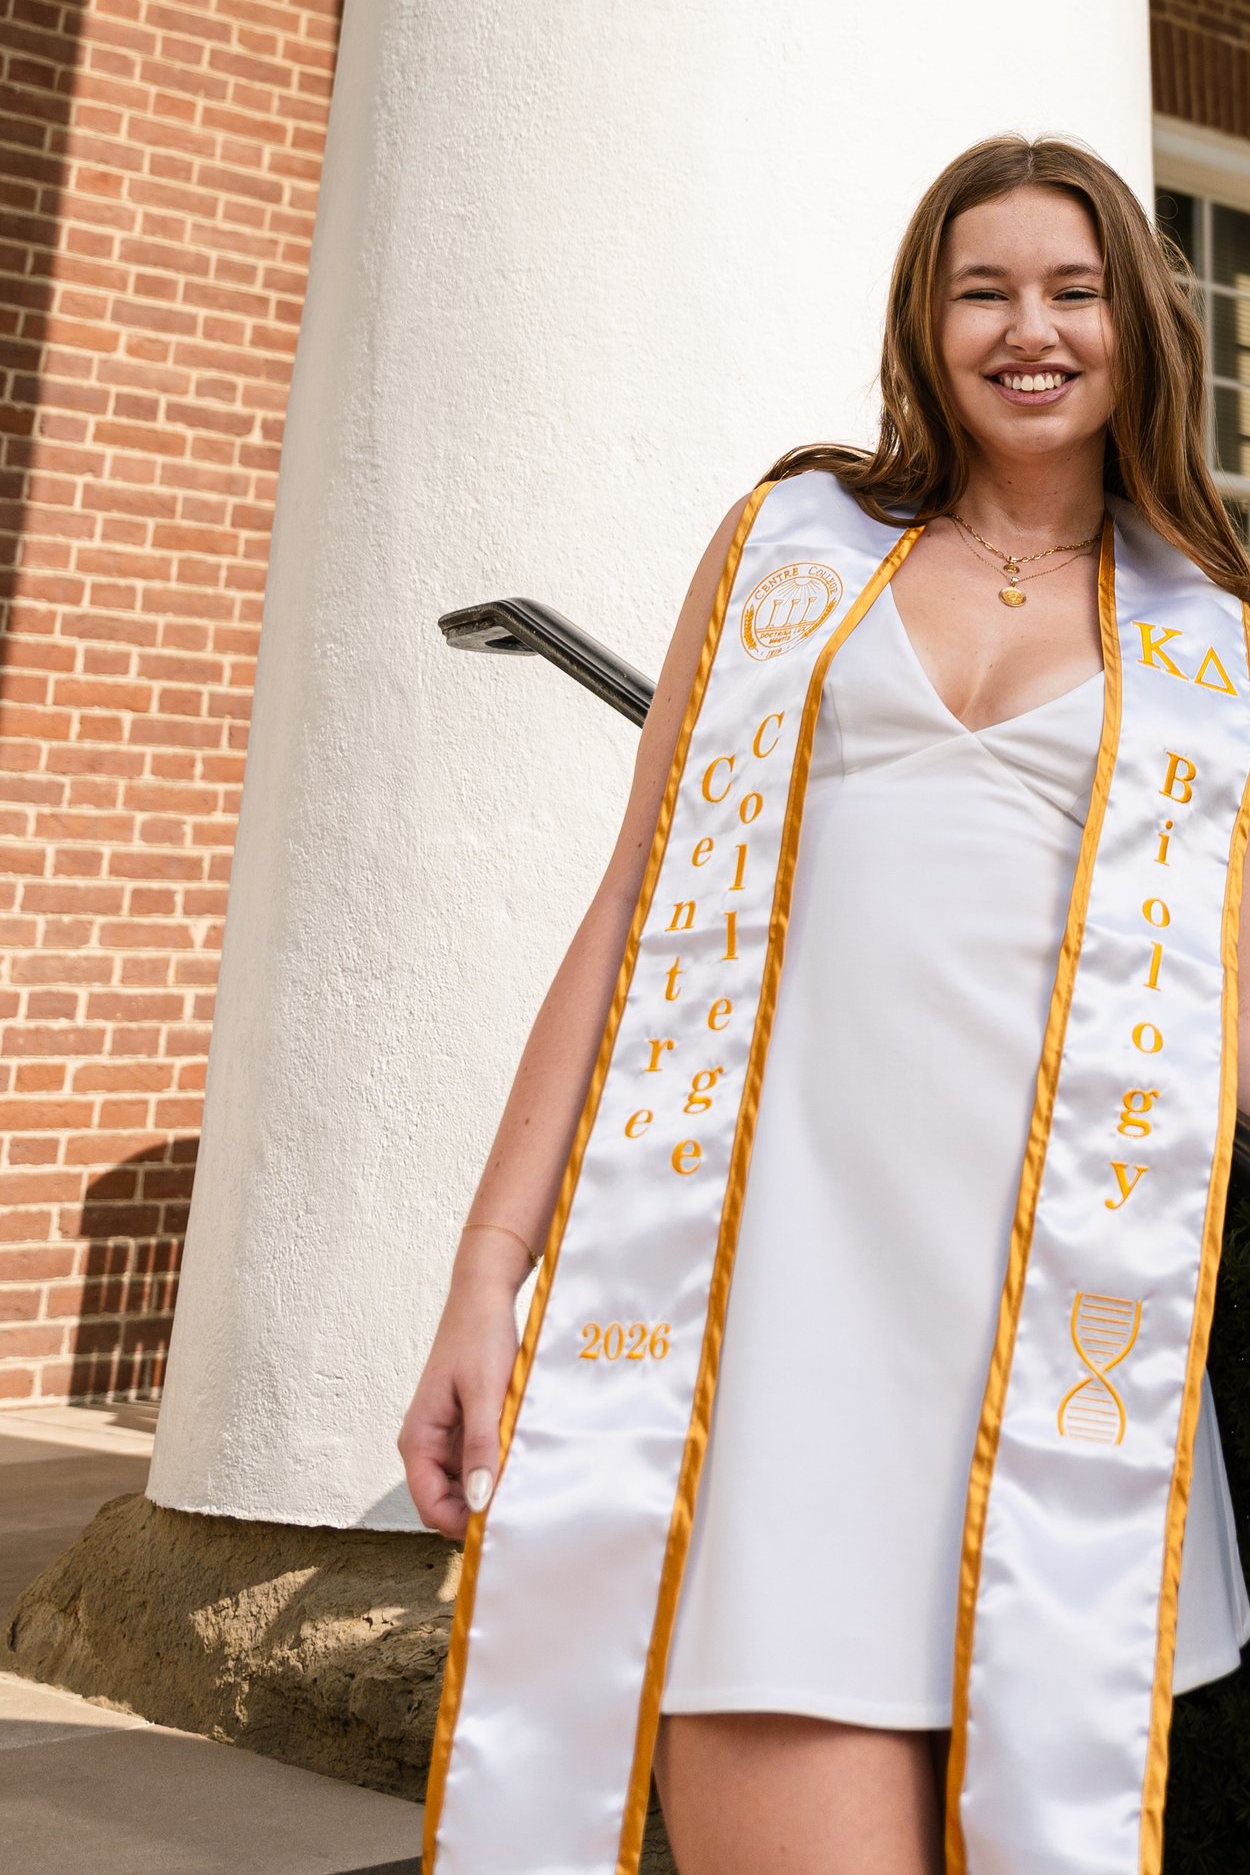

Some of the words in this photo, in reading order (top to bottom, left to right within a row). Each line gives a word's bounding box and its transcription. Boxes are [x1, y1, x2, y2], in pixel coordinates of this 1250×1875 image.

[755, 567, 799, 601] CENTRE
[623, 755, 736, 1139] Centre
[671, 712, 786, 1175] College
[1104, 751, 1198, 1210] Biology
[579, 1323, 670, 1361] 2026
